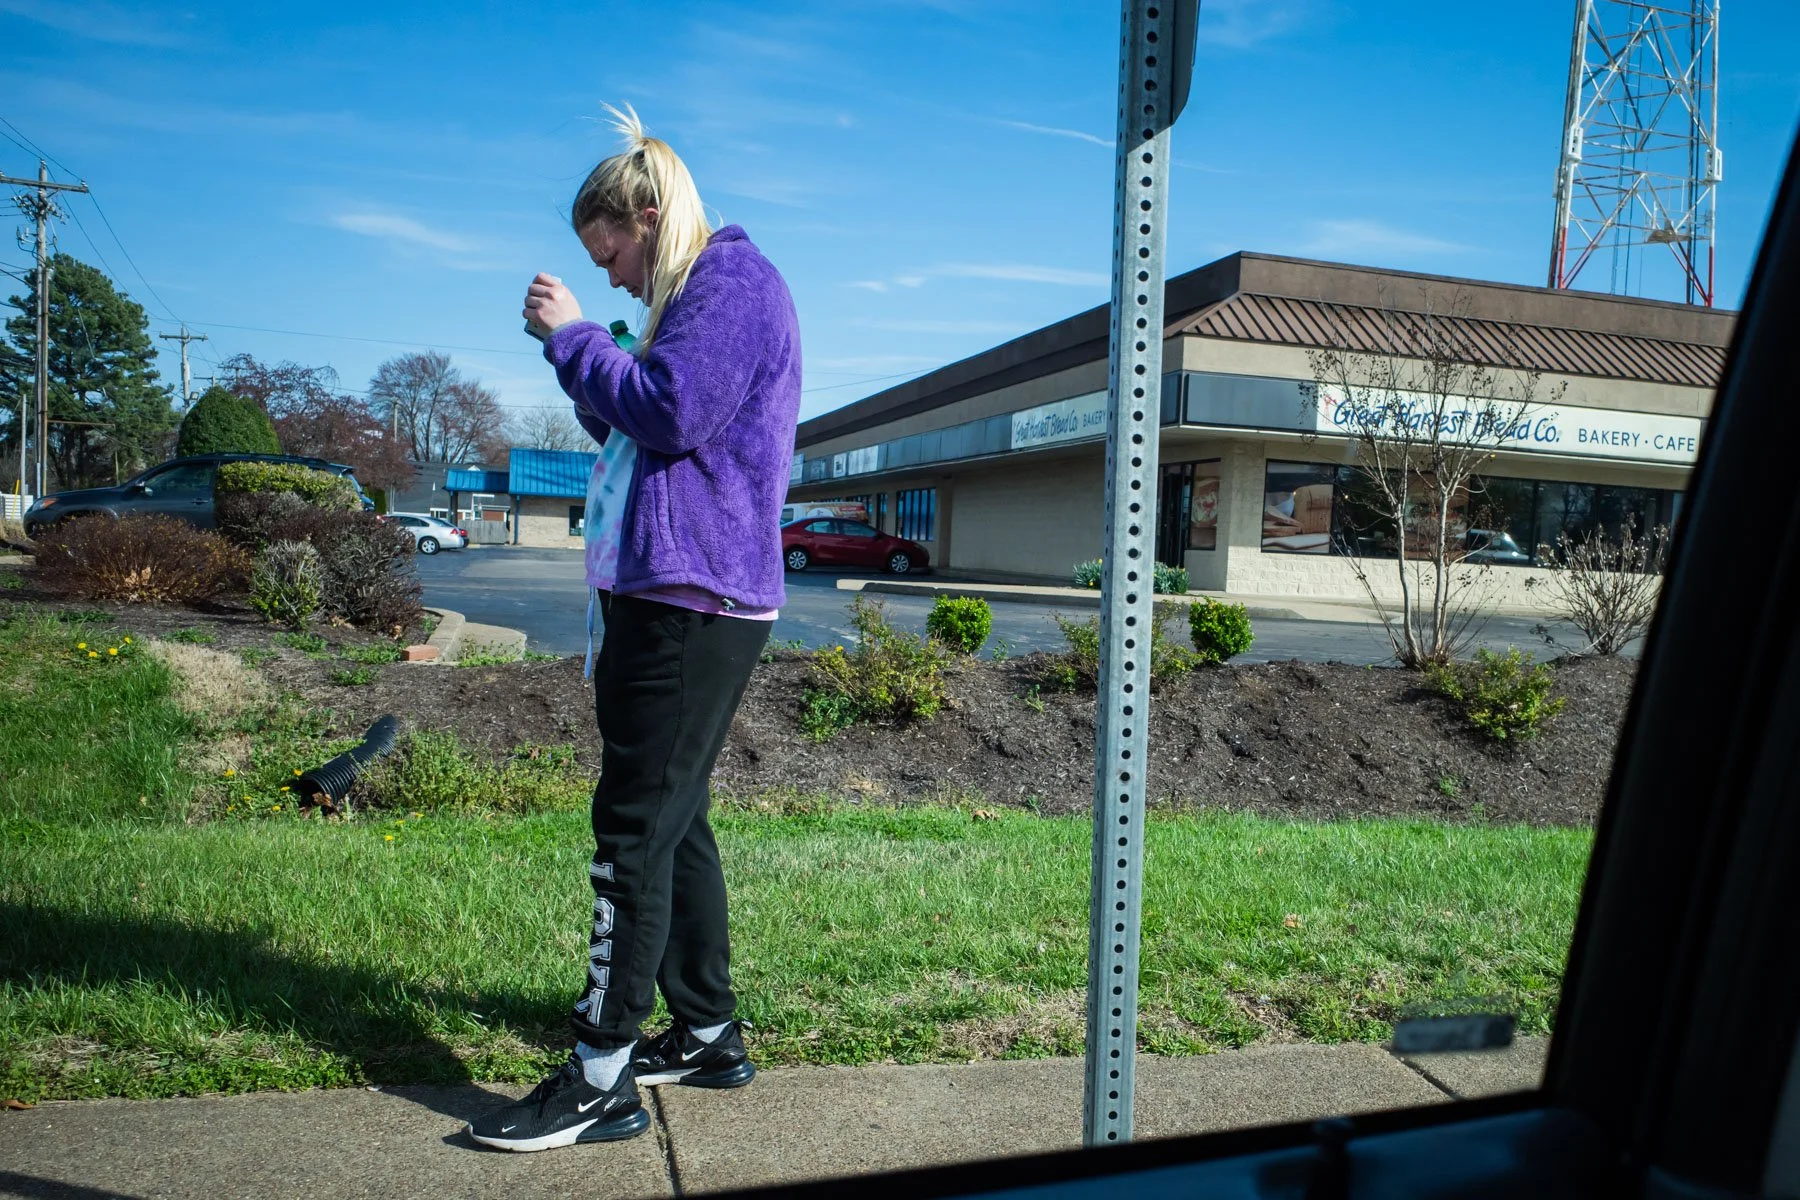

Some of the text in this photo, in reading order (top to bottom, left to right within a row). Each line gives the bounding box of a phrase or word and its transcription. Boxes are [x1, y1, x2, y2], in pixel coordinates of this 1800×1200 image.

[1333, 400, 1389, 428] Great
[1395, 401, 1472, 435] Harvest
[1534, 417, 1560, 442] Co.
[1579, 428, 1695, 452] BAKERY CAFE
